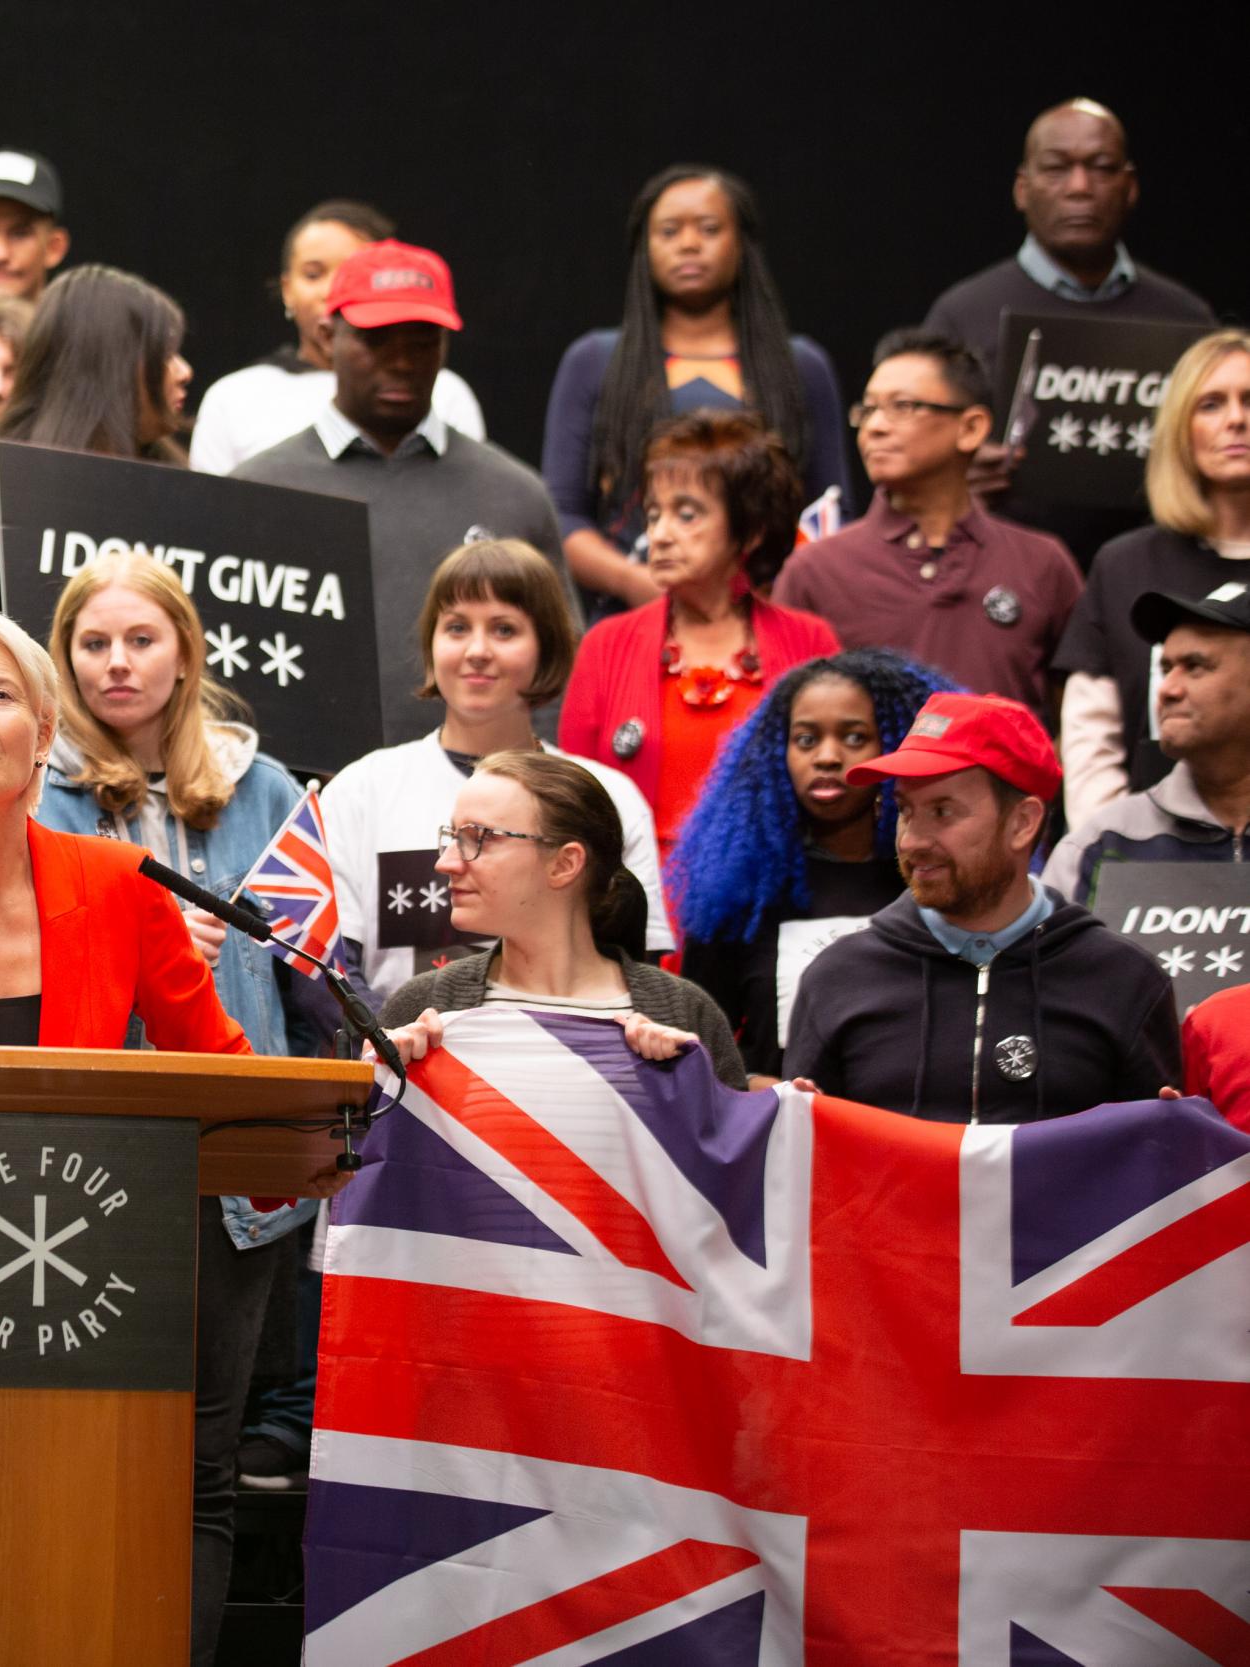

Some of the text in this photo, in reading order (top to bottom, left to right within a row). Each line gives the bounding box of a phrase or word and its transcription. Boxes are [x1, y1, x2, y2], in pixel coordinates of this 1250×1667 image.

[1034, 363, 1139, 405] DON'T
[39, 528, 56, 574] I
[208, 555, 310, 614] GIVE
[311, 573, 346, 620] A
[1121, 906, 1250, 934] I DON'T
[40, 1147, 128, 1216] FOUR
[38, 1272, 136, 1355] PARTY
